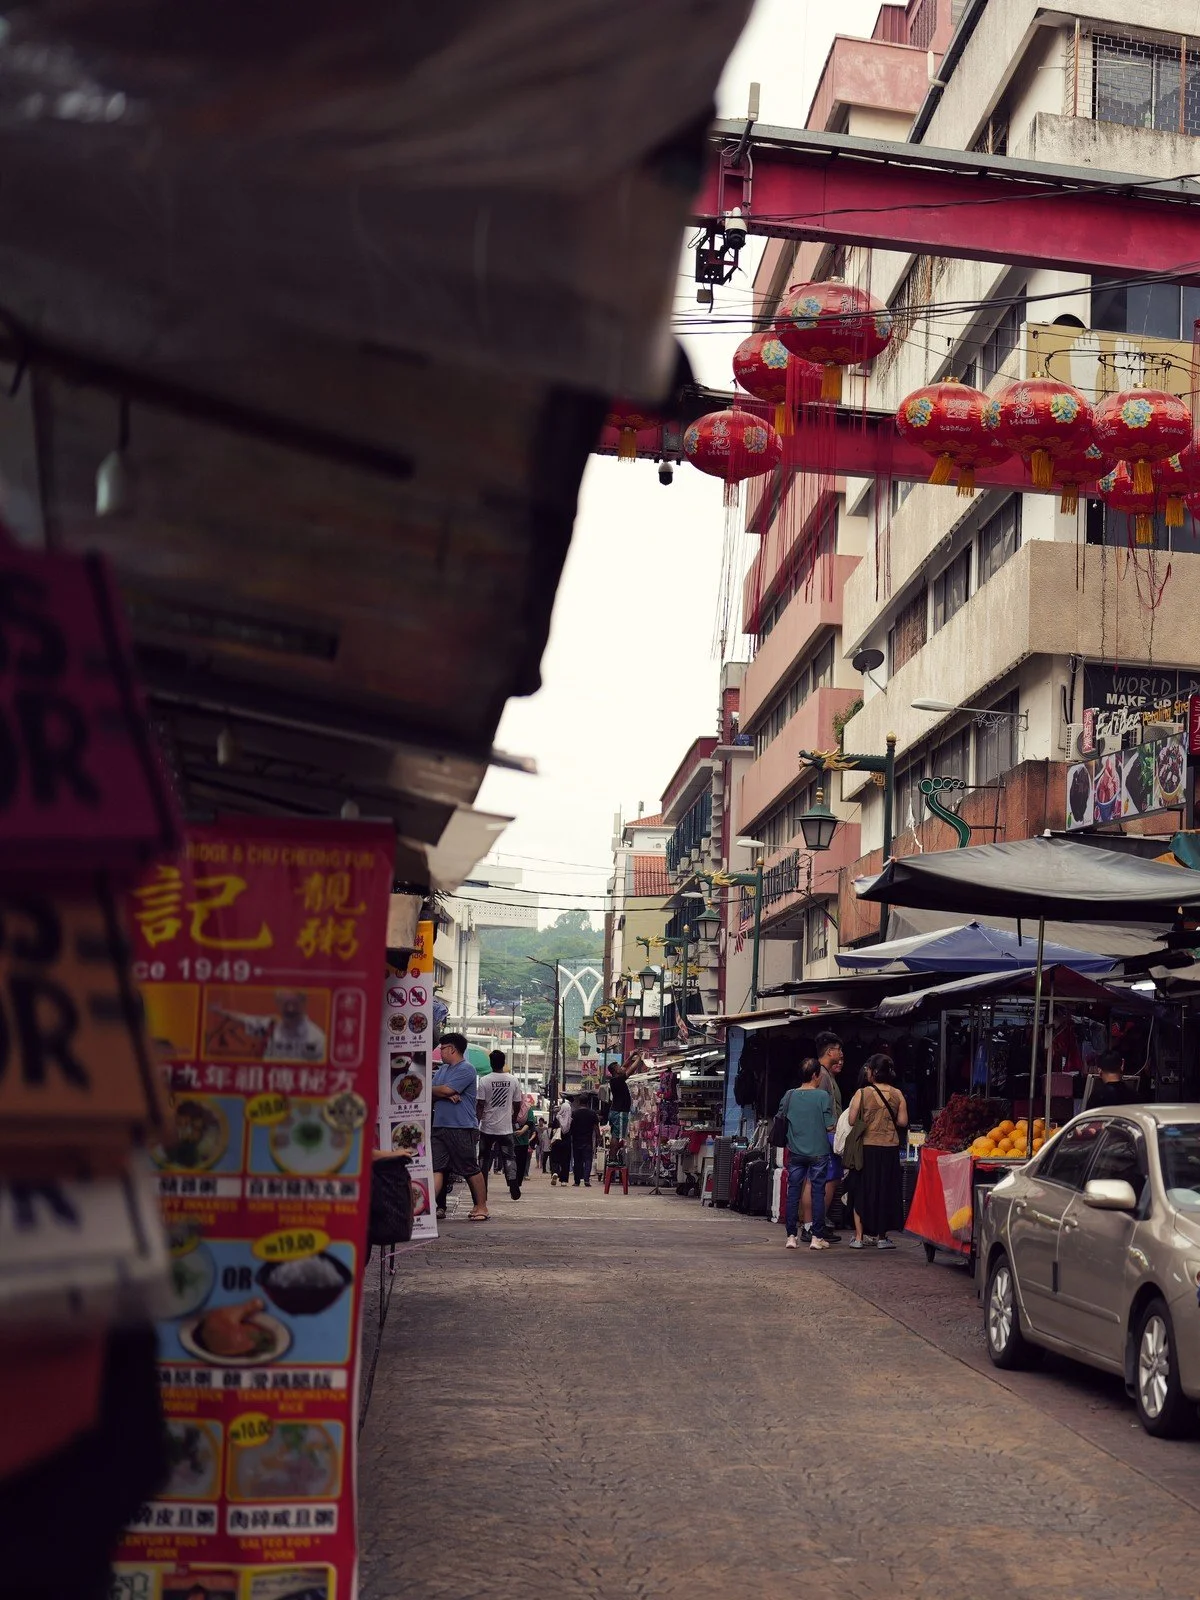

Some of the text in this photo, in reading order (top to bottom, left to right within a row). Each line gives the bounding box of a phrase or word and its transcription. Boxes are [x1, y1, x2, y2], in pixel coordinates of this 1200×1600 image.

[1112, 674, 1172, 695] WORLD
[1106, 693, 1146, 708] MAKE
[133, 866, 274, 949] 記
[177, 956, 251, 982] 1949
[222, 1264, 253, 1291] OR
